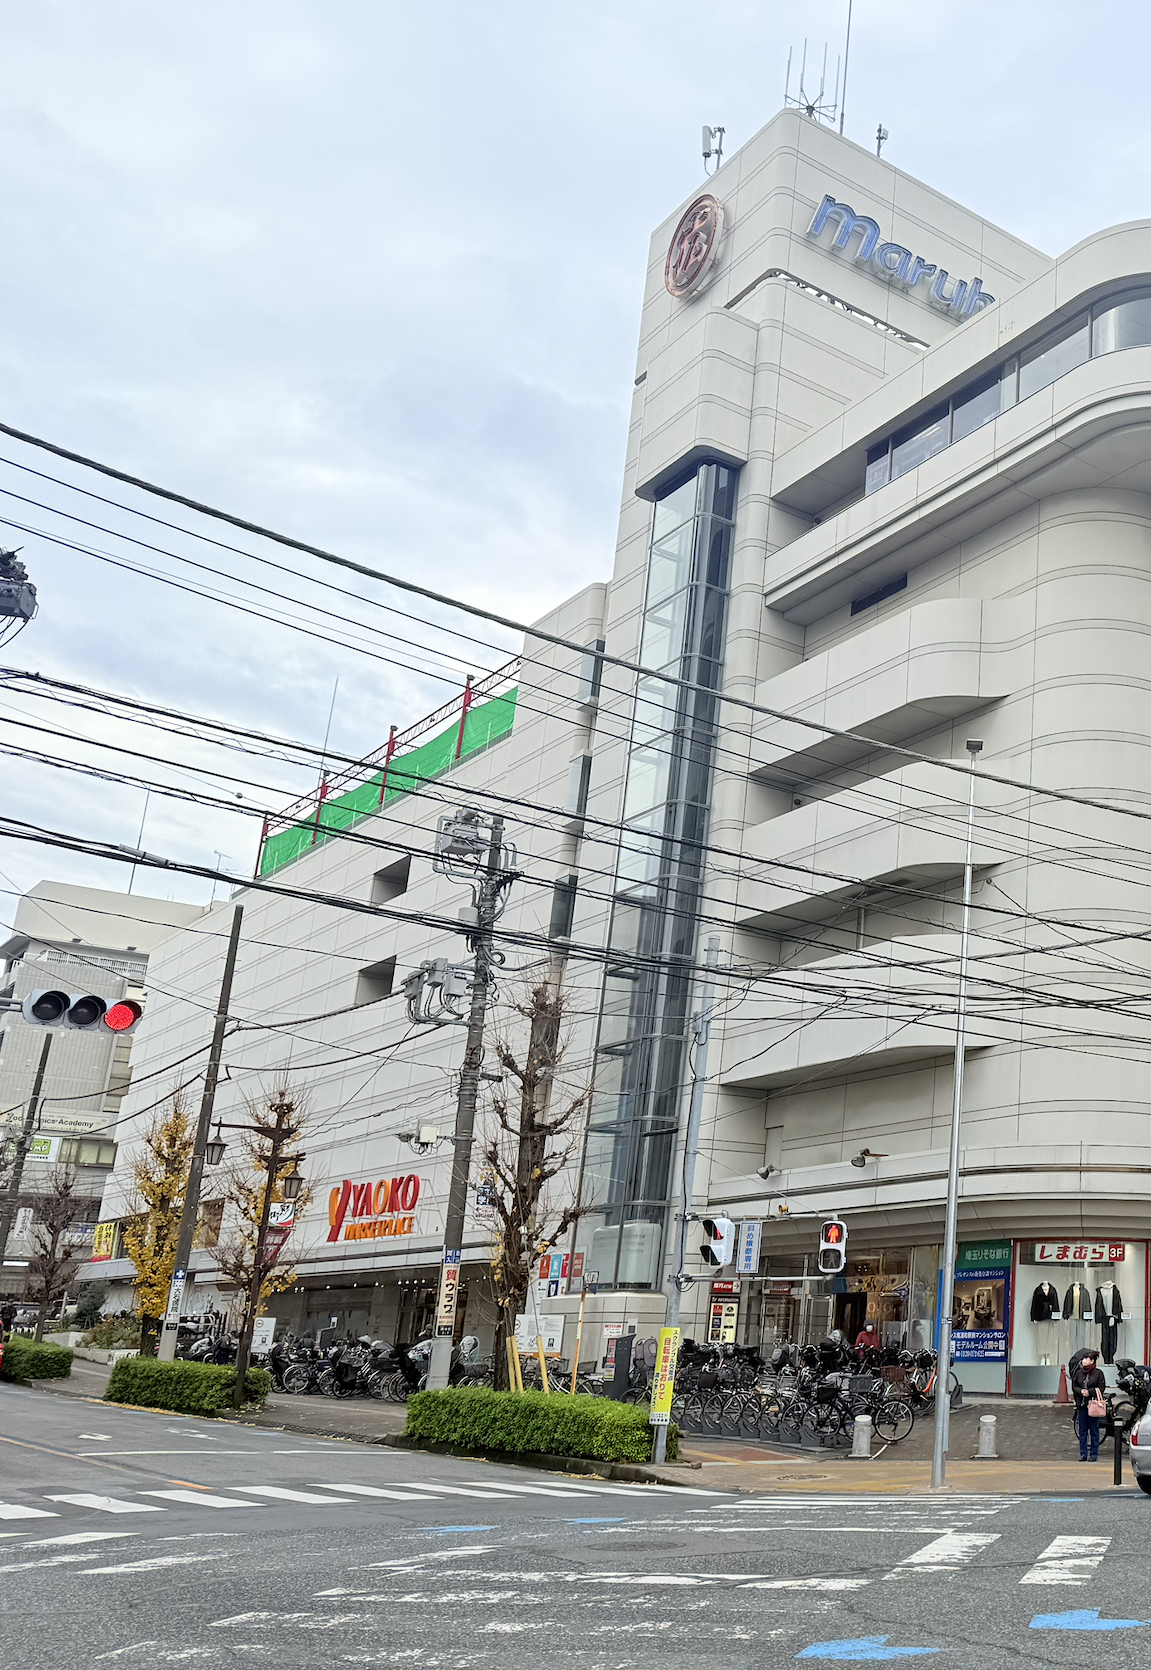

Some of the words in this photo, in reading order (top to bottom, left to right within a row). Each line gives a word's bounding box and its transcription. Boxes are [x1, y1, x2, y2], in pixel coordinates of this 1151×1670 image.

[58, 1118, 94, 1128] Academy
[351, 1174, 420, 1218] YAOKO
[965, 1248, 1010, 1261] 埼玉りそな銀行
[1039, 1245, 1105, 1260] しまむら
[1109, 1247, 1123, 1258] 3F
[659, 1337, 671, 1400] 自転車はおりて
